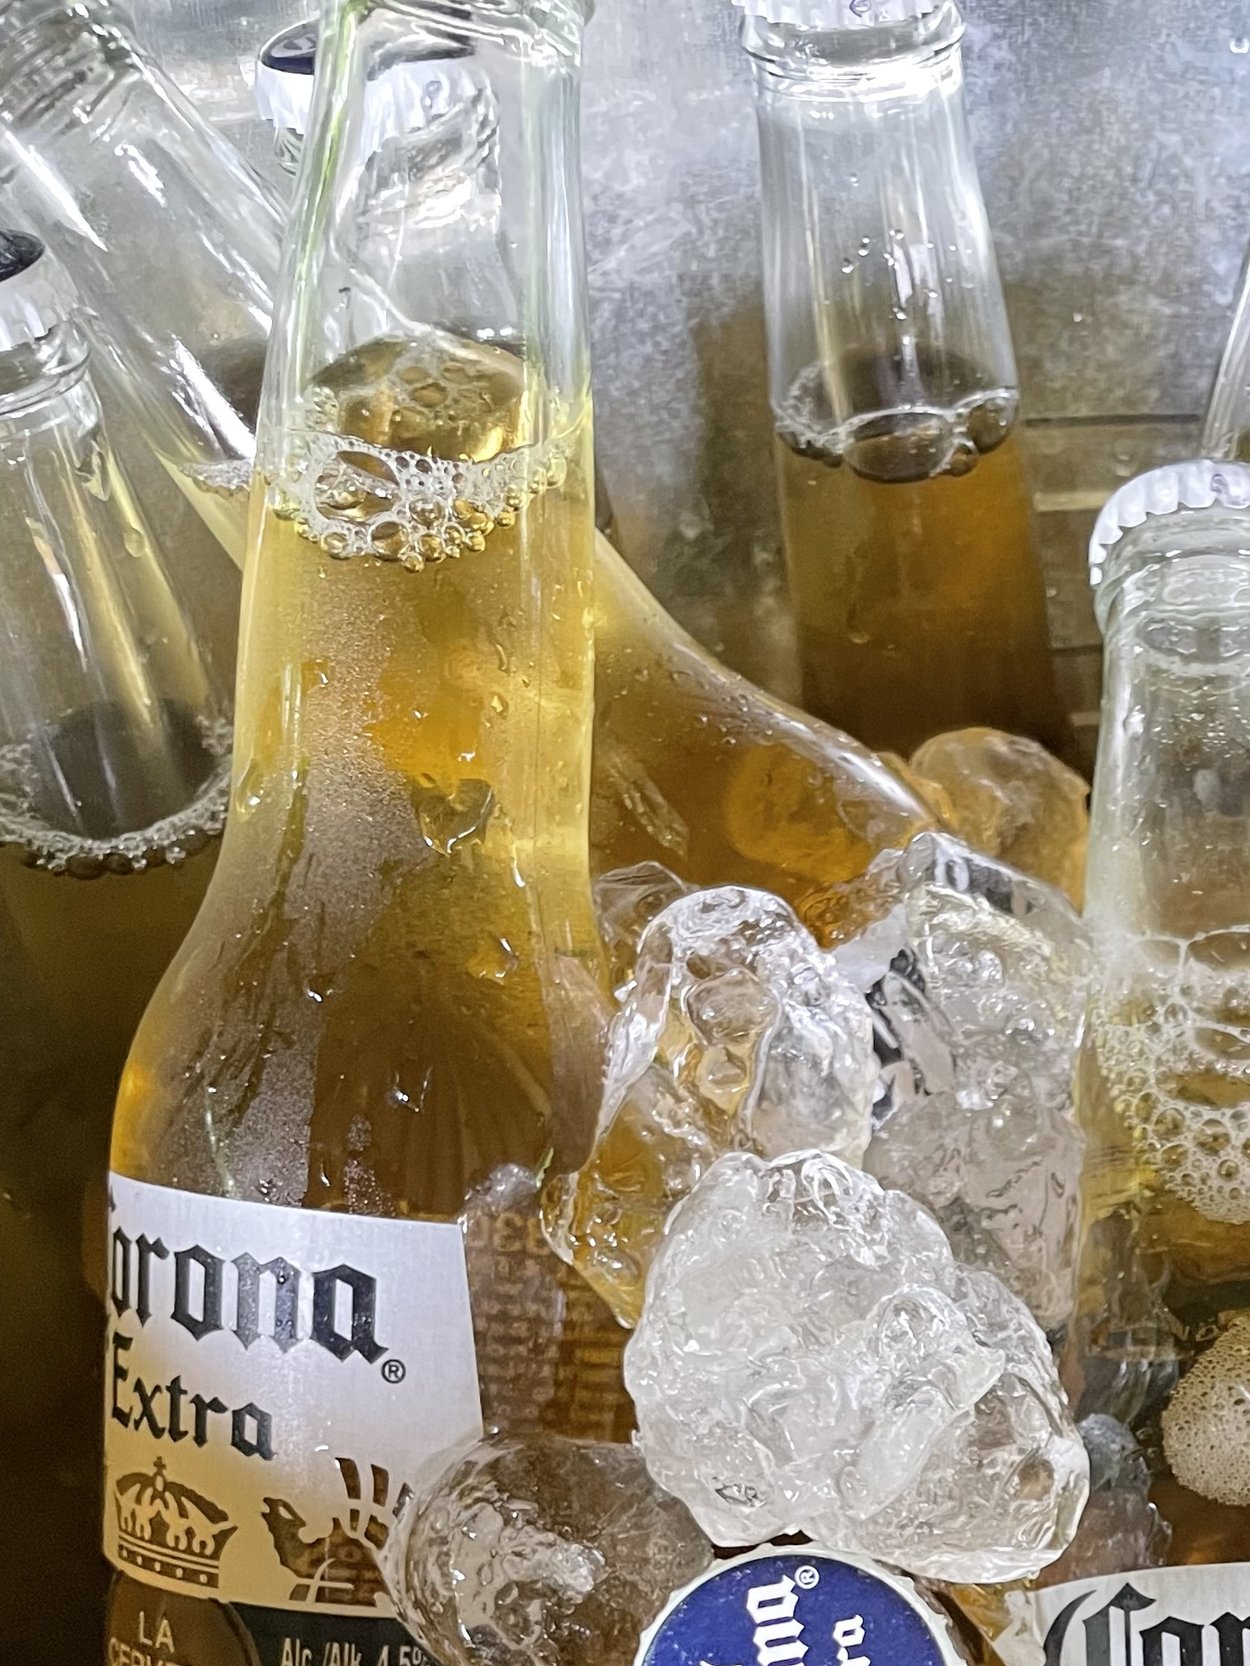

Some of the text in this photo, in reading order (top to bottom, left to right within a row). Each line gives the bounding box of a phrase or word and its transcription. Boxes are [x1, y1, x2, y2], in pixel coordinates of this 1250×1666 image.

[111, 1226, 389, 1363] orona
[112, 1332, 274, 1461] Extra
[139, 1610, 175, 1653] LA
